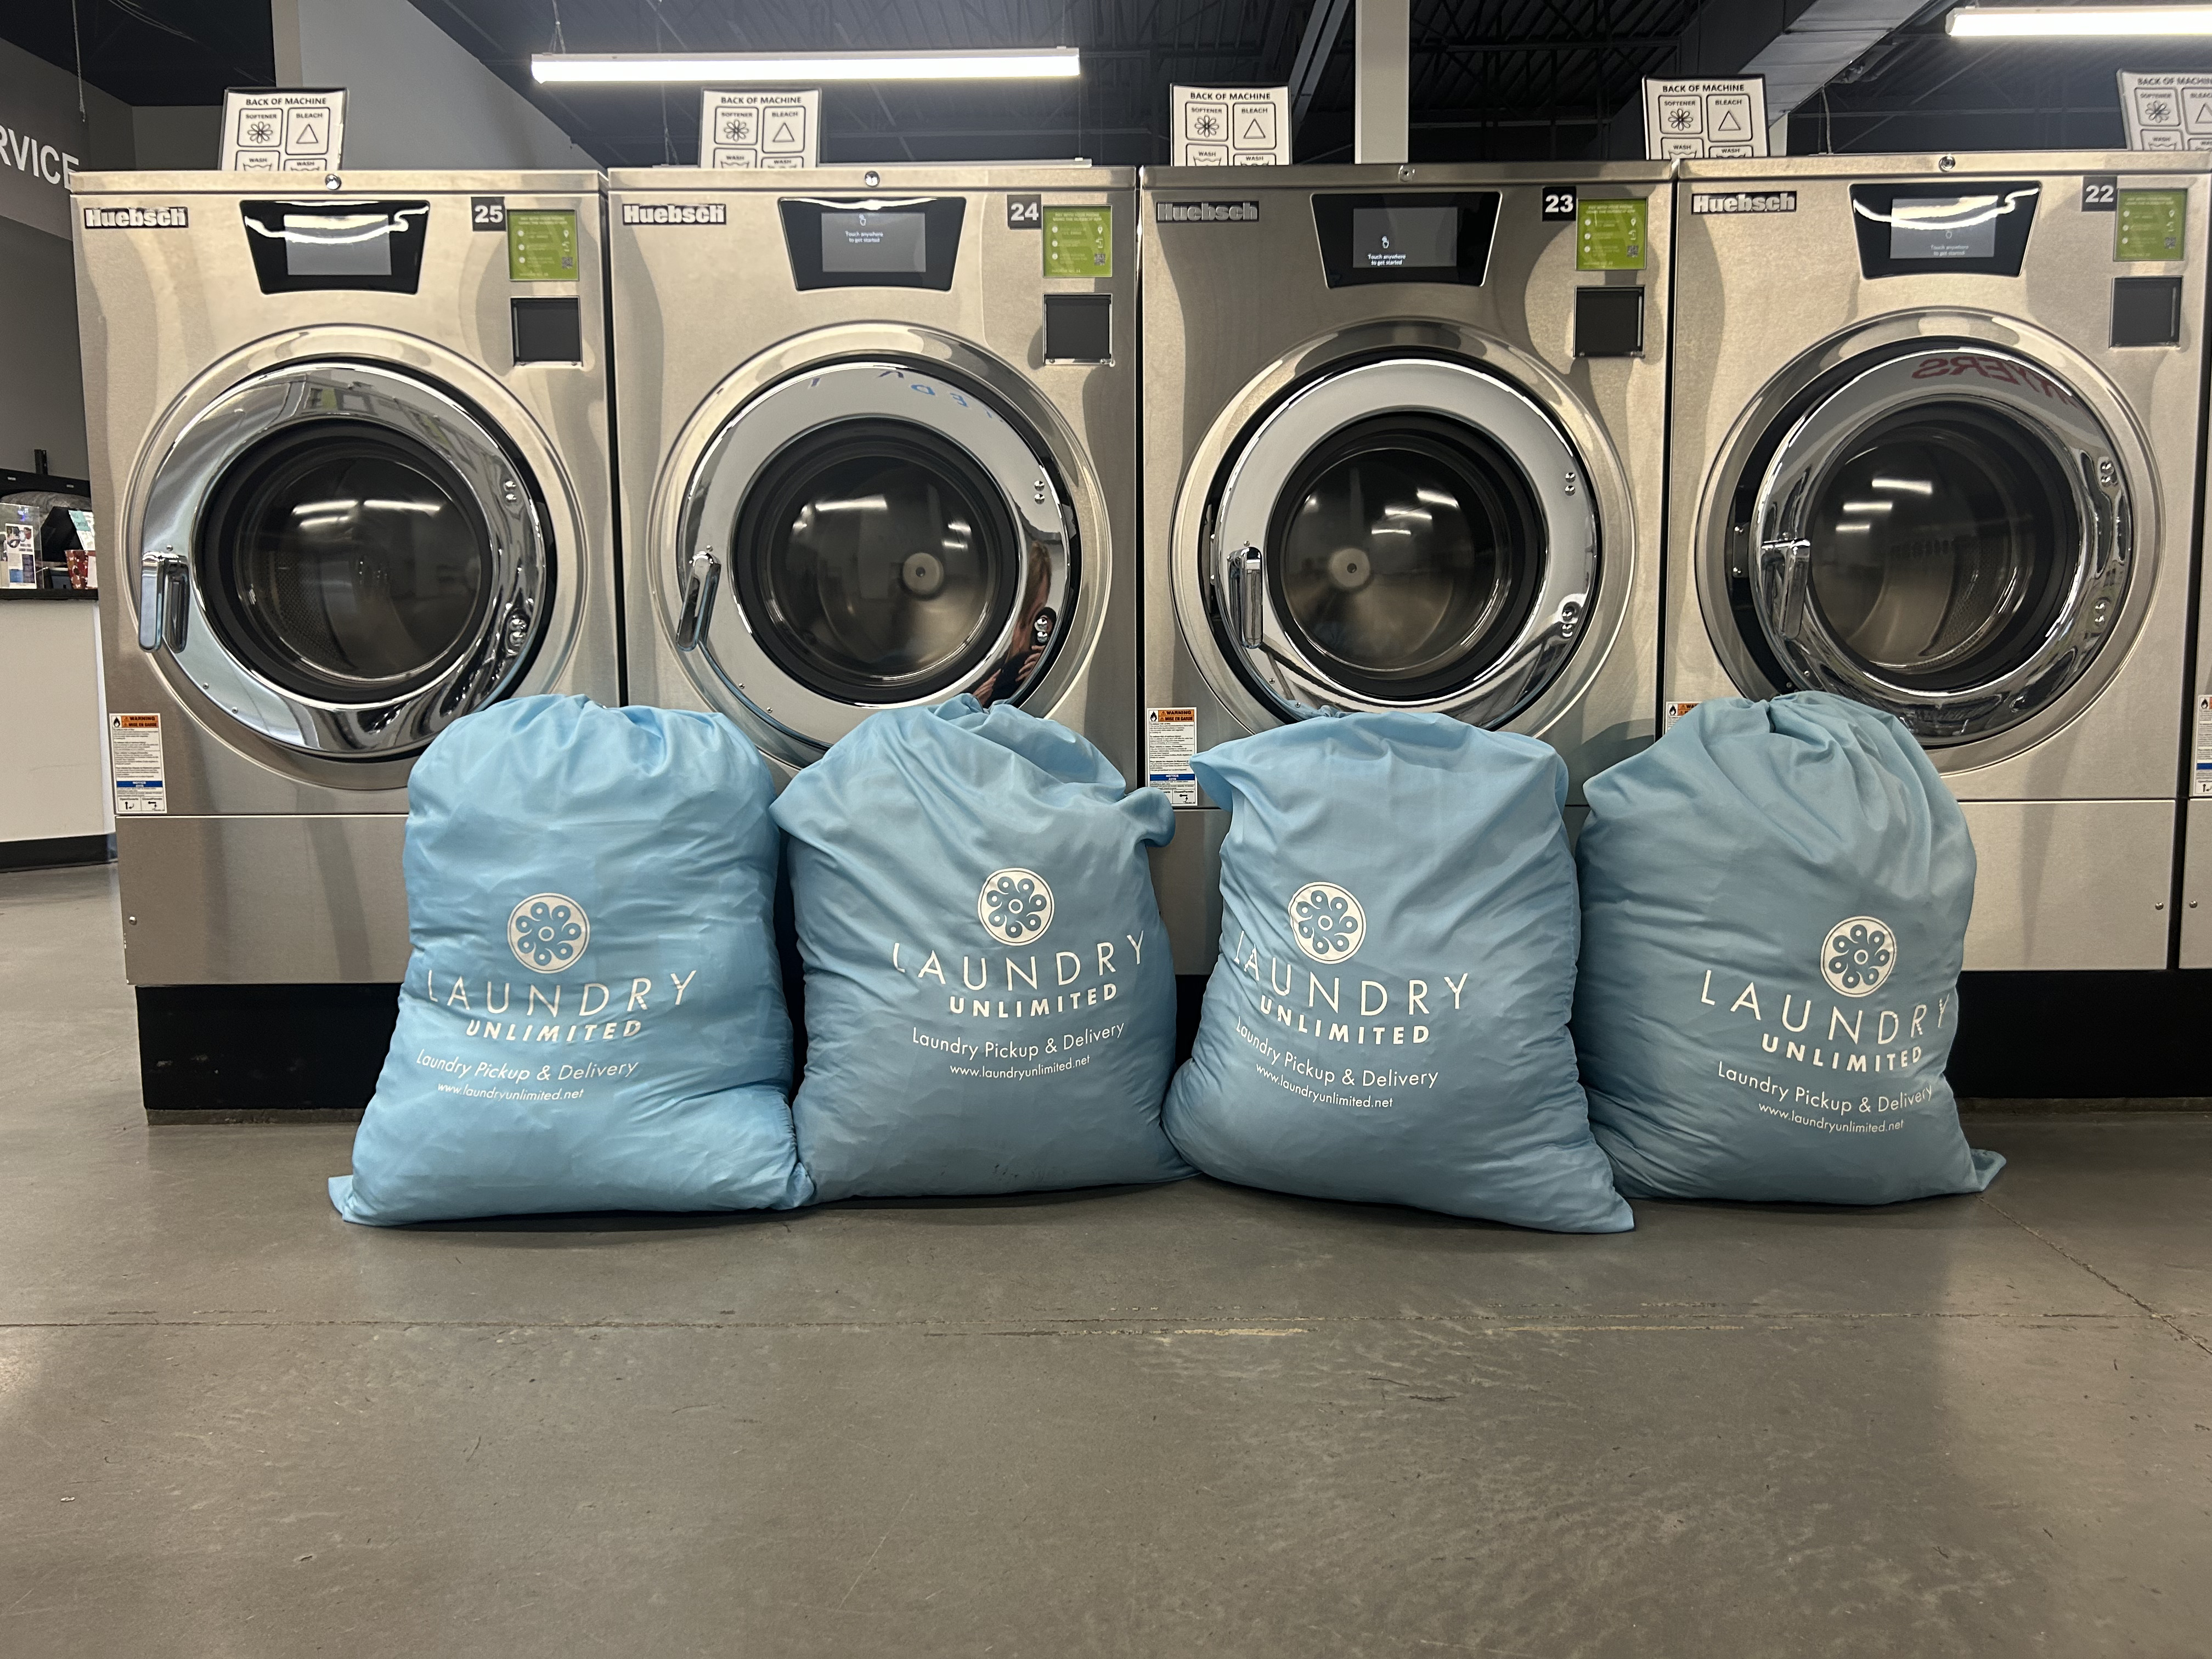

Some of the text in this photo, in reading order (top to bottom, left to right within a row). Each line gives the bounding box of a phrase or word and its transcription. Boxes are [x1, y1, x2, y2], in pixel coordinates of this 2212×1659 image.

[1545, 194, 1573, 213] 23
[1693, 193, 1795, 212] Huebsch
[2085, 185, 2114, 202] 22
[85, 208, 186, 227] Huebsch
[475, 205, 503, 223] 25
[624, 205, 724, 224] Huebsch
[1011, 202, 1039, 221] 24
[1158, 201, 1257, 221] Huebsch
[893, 930, 1144, 991] LAUNDRY
[427, 969, 697, 1018] LAUNDRY
[949, 983, 1117, 1018] UNLIMITED
[1701, 969, 1950, 1045] LAUNDRY
[466, 1019, 642, 1042] UNLIMITED
[1260, 995, 1430, 1045] UNLIMITED
[912, 1023, 1125, 1061] Laundry Pickup & Delivery
[1235, 1017, 1438, 1088] Laundry Pickup & Delivery
[1762, 1033, 1922, 1072] UNLIMITED
[416, 1048, 639, 1084] Laundry Pickup & Delivery
[950, 1055, 1090, 1081] www.laundryunlimited.net
[437, 1082, 584, 1101] www.laundryunlimited.net
[1255, 1063, 1393, 1108] www.laundryunlimited.net
[1718, 1061, 1932, 1116] Laundry Pickup & Delivery
[1758, 1102, 1904, 1134] www.laundryunlimited.net
